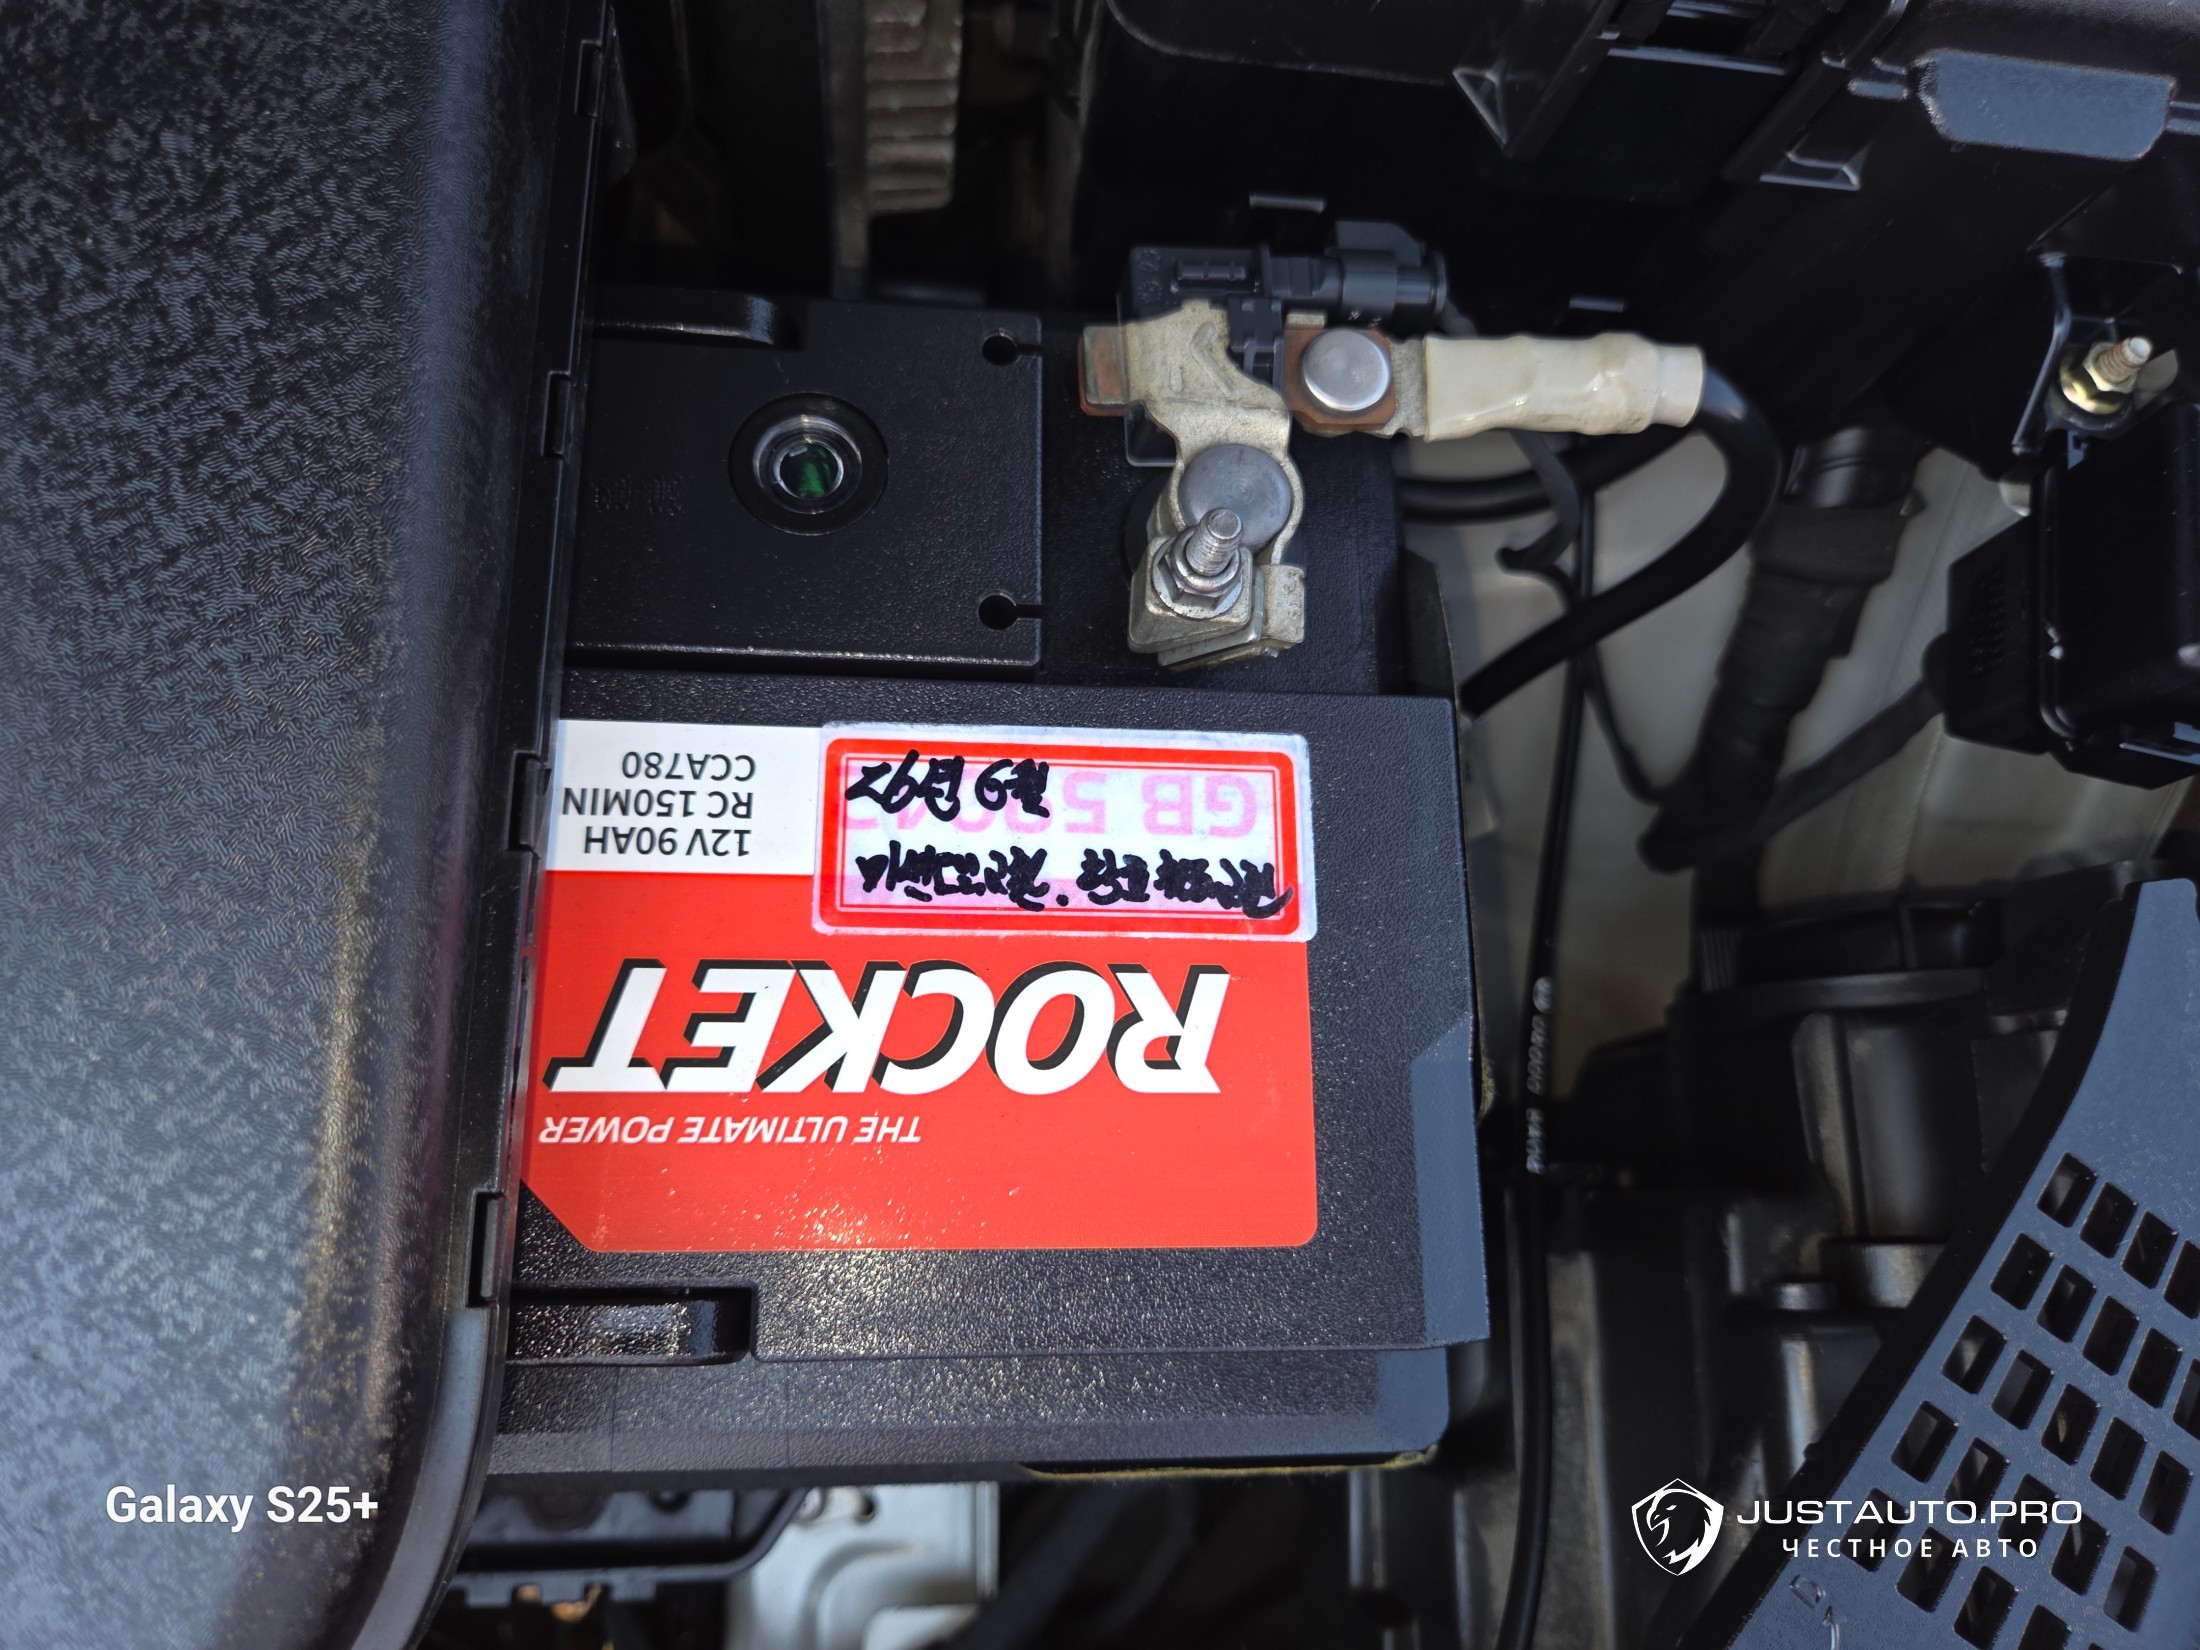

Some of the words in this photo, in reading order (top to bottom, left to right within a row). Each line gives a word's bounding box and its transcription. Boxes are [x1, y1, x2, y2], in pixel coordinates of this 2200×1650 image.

[621, 751, 756, 782] CCA780
[562, 787, 697, 818] 150MIN
[707, 791, 754, 819] RC
[1141, 773, 1258, 838] GB
[584, 826, 678, 856] 90AH
[685, 828, 752, 857] 12V
[541, 957, 1230, 1096] ROCKET
[538, 1115, 675, 1144] POWER
[677, 1115, 849, 1144] ULTIMATE
[853, 1115, 921, 1144] THE
